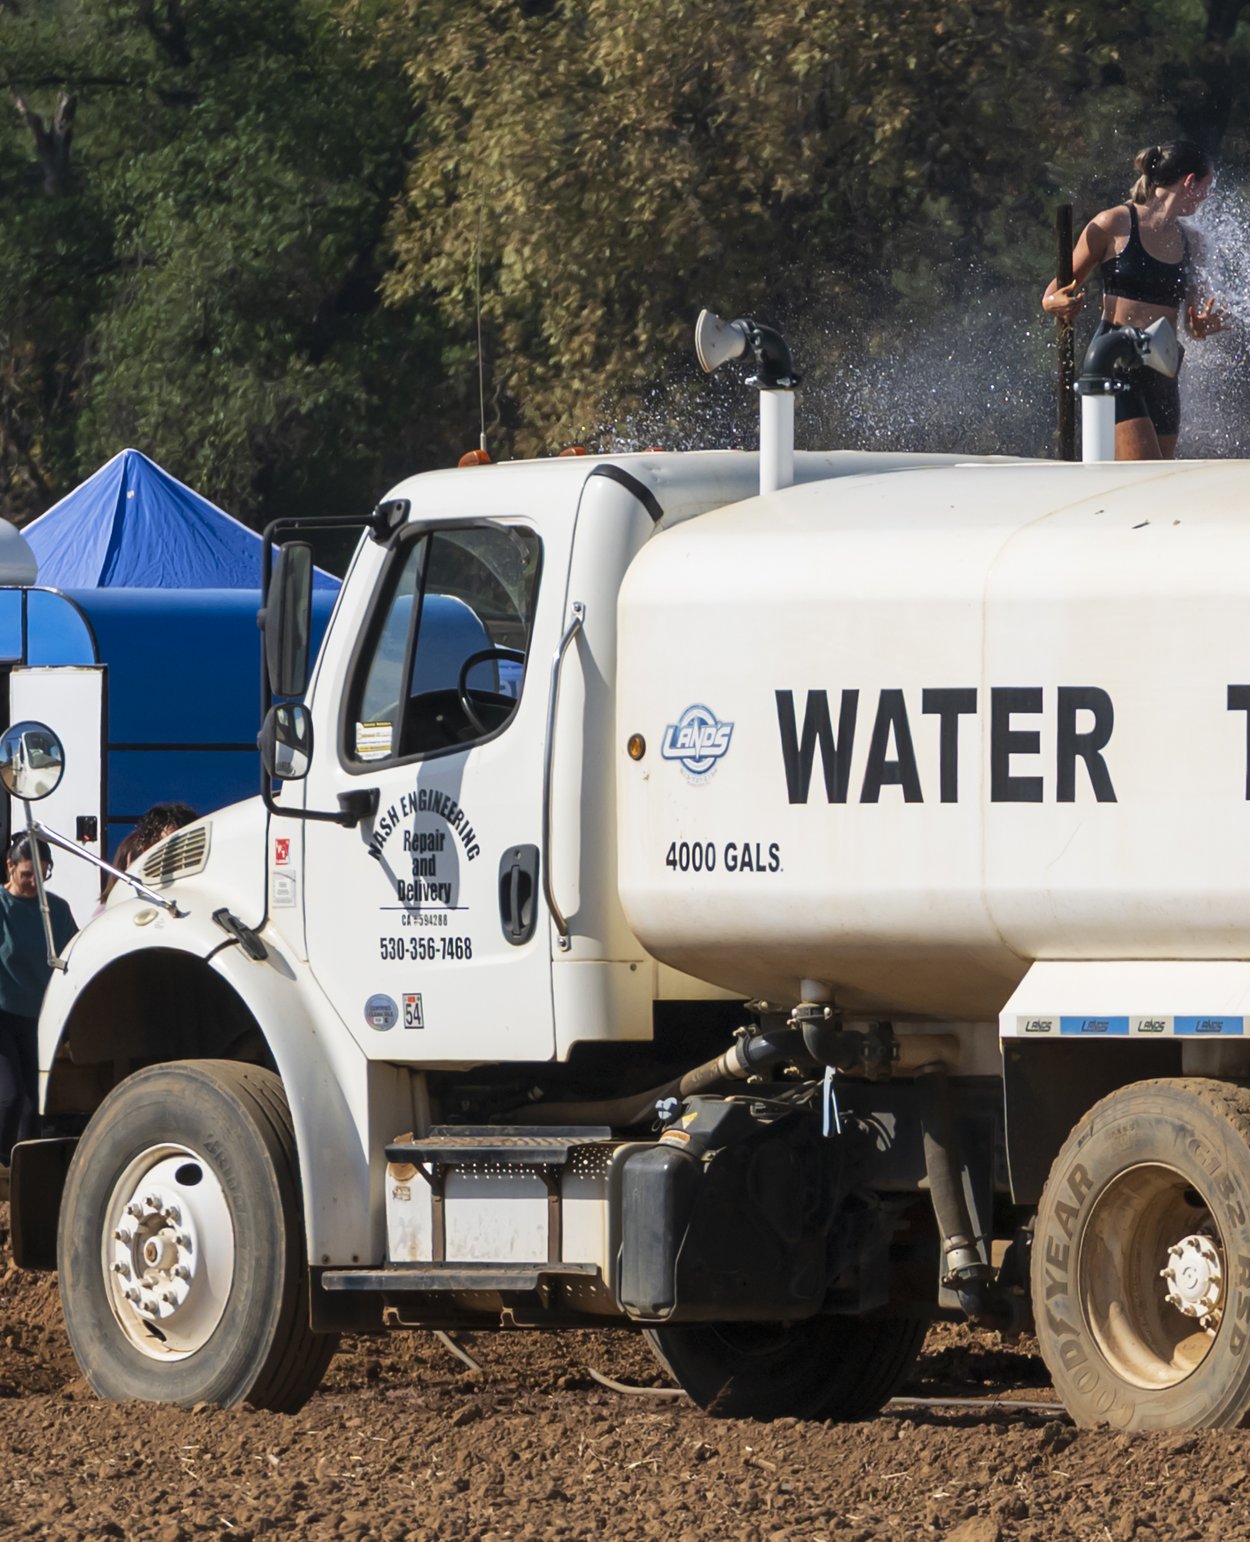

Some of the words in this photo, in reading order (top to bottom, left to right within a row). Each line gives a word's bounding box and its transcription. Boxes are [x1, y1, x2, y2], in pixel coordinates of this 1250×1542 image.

[775, 686, 1118, 804] WATER
[368, 804, 400, 861] NASH
[400, 788, 481, 861] ENGINEERING
[403, 829, 446, 854] Repair
[411, 854, 436, 877] and
[665, 841, 716, 872] 4000
[723, 842, 784, 872] GALS.
[397, 879, 452, 904] Delivery
[401, 914, 411, 926] CA
[380, 937, 472, 960] 530-356-7468
[405, 1003, 421, 1025] 54
